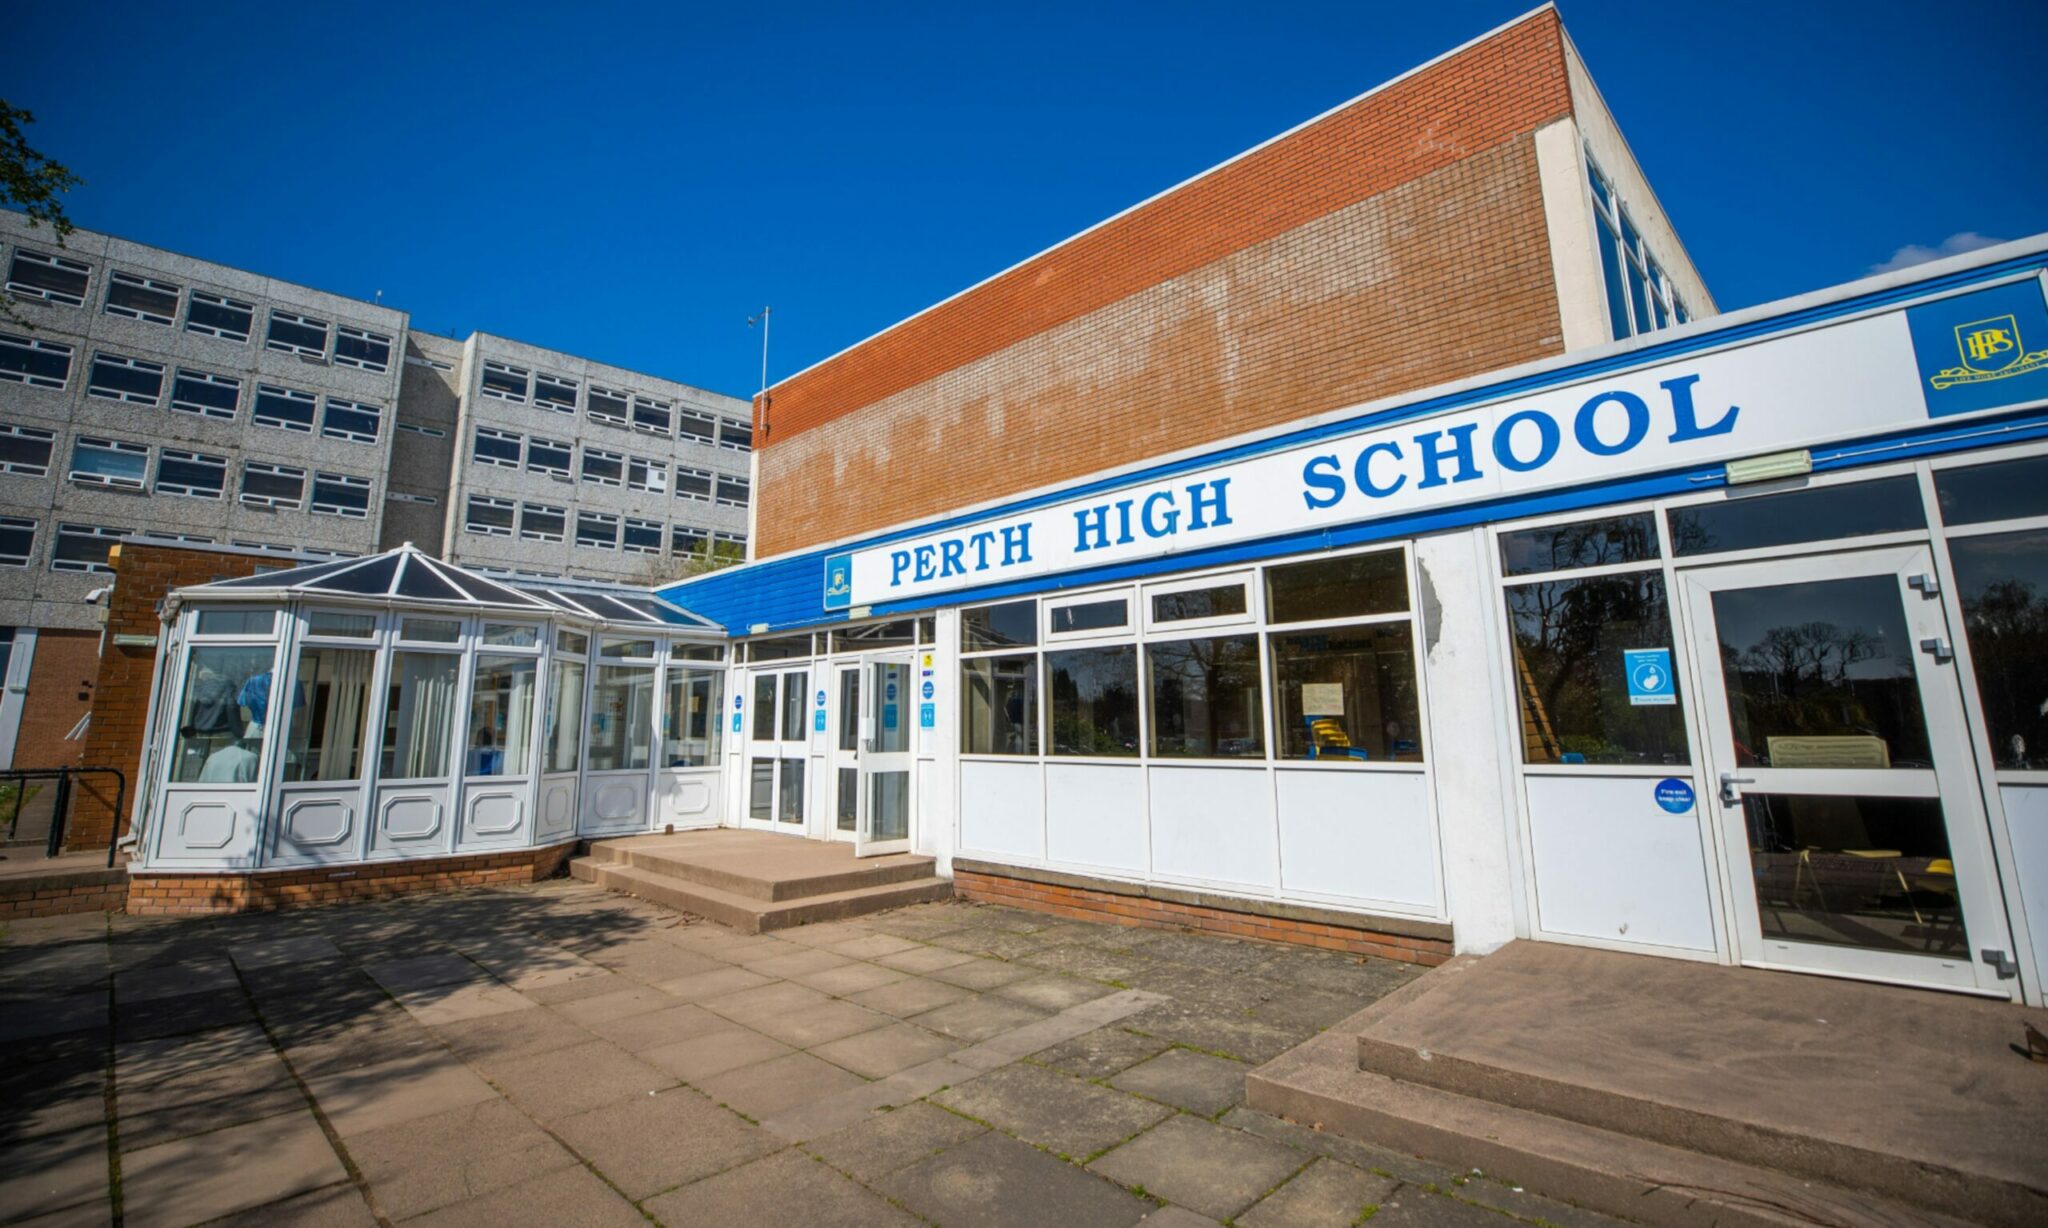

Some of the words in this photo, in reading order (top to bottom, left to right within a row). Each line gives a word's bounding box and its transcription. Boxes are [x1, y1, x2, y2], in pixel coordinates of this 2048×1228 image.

[890, 522, 1033, 587] PERTH
[1073, 477, 1233, 553] HIGH
[1302, 373, 1740, 511] SCHOOL
